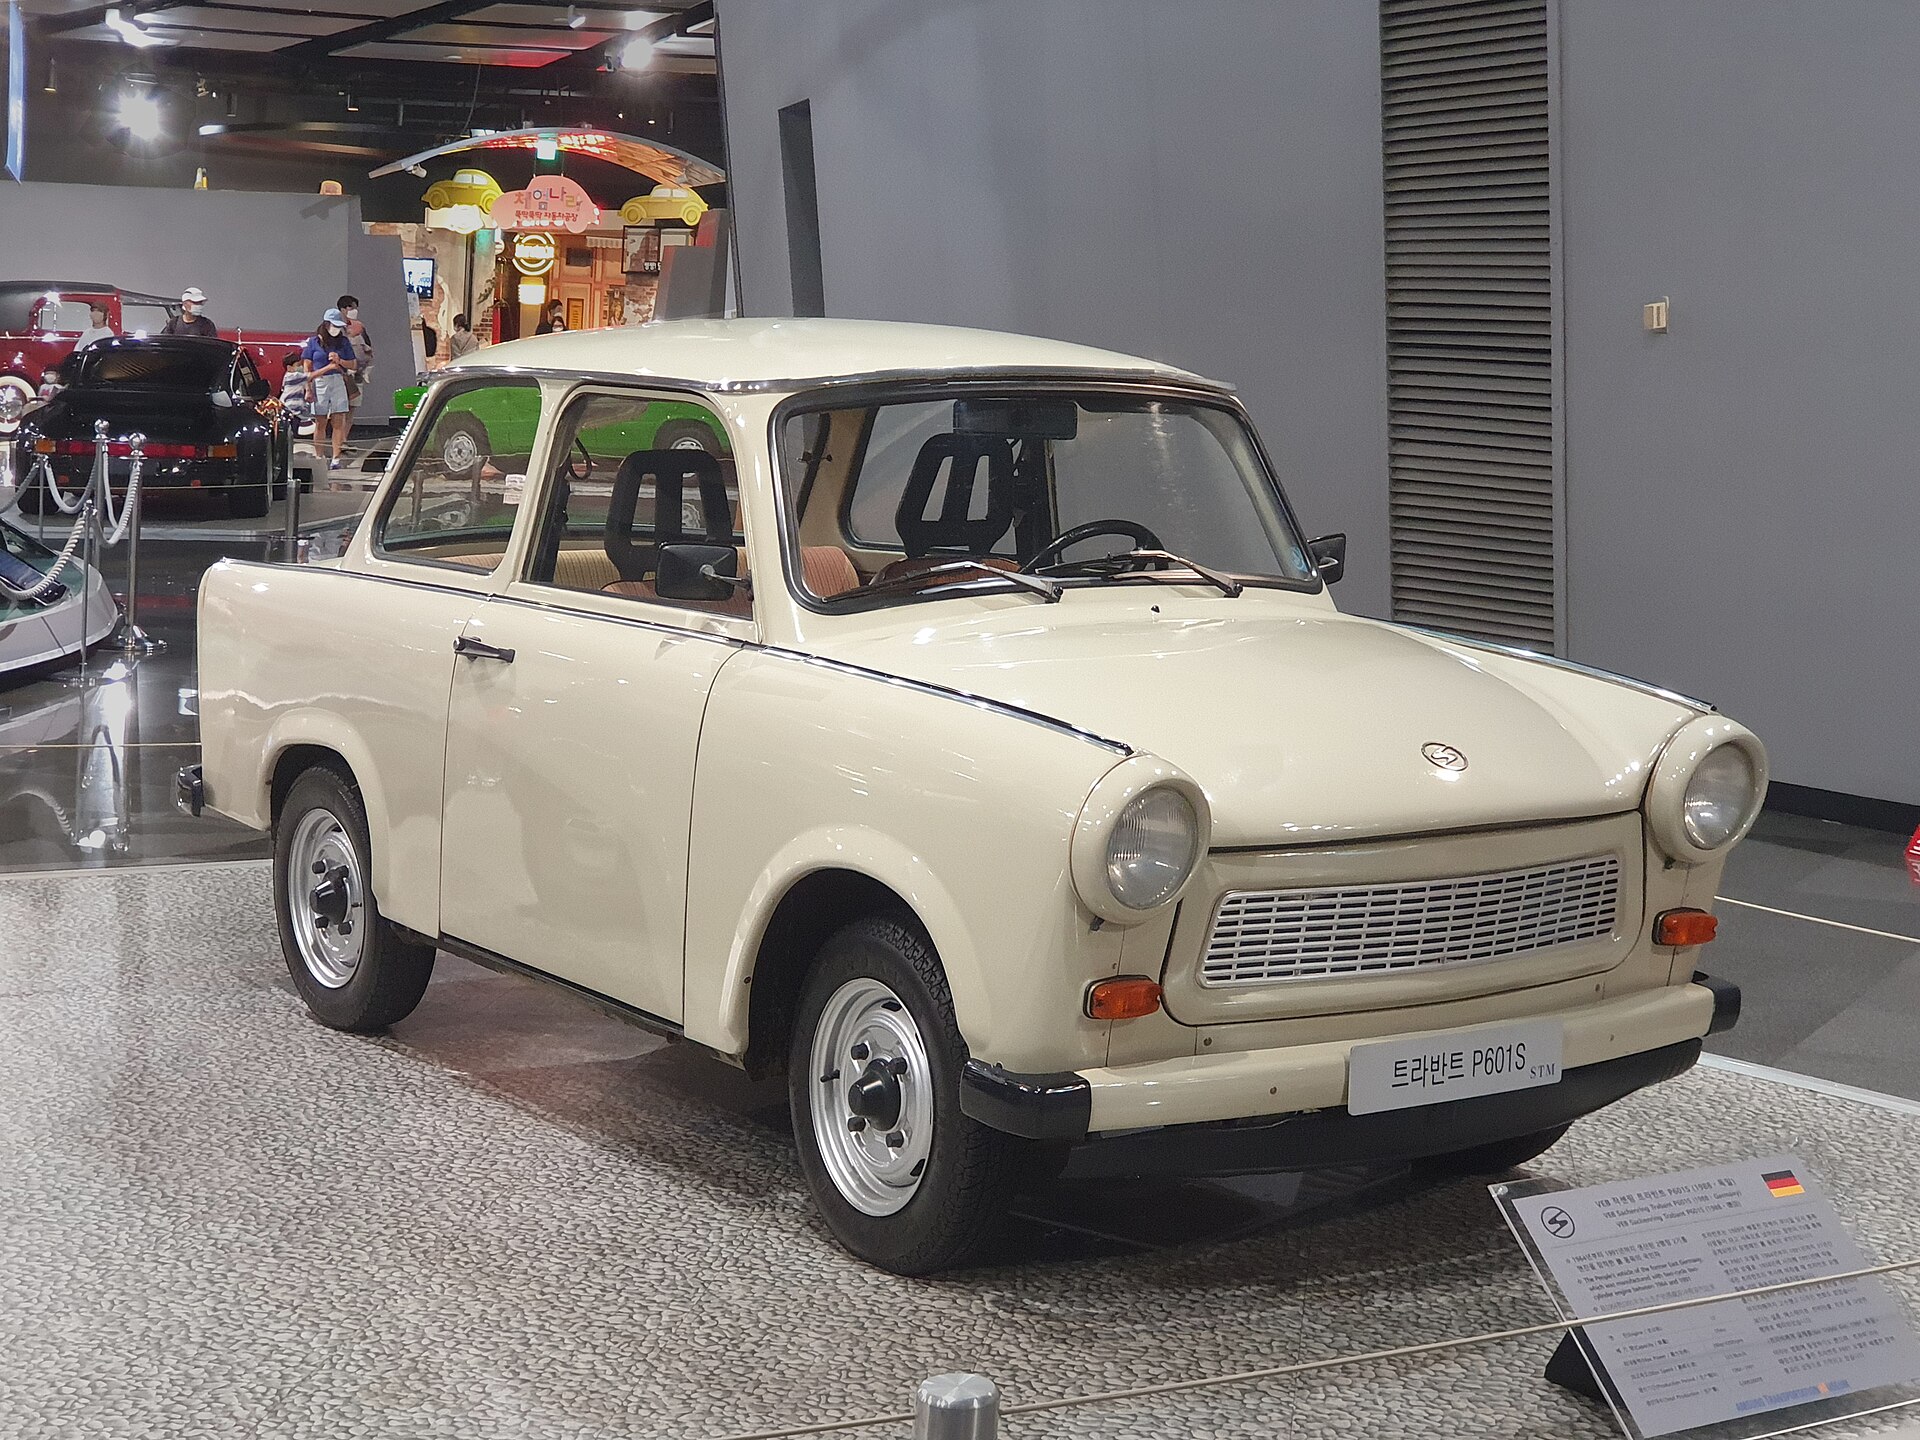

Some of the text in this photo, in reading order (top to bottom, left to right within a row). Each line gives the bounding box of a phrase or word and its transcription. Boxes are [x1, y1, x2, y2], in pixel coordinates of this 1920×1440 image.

[544, 212, 578, 222] 자동차공장
[1392, 1042, 1556, 1088] 트라반트 P601S STM
